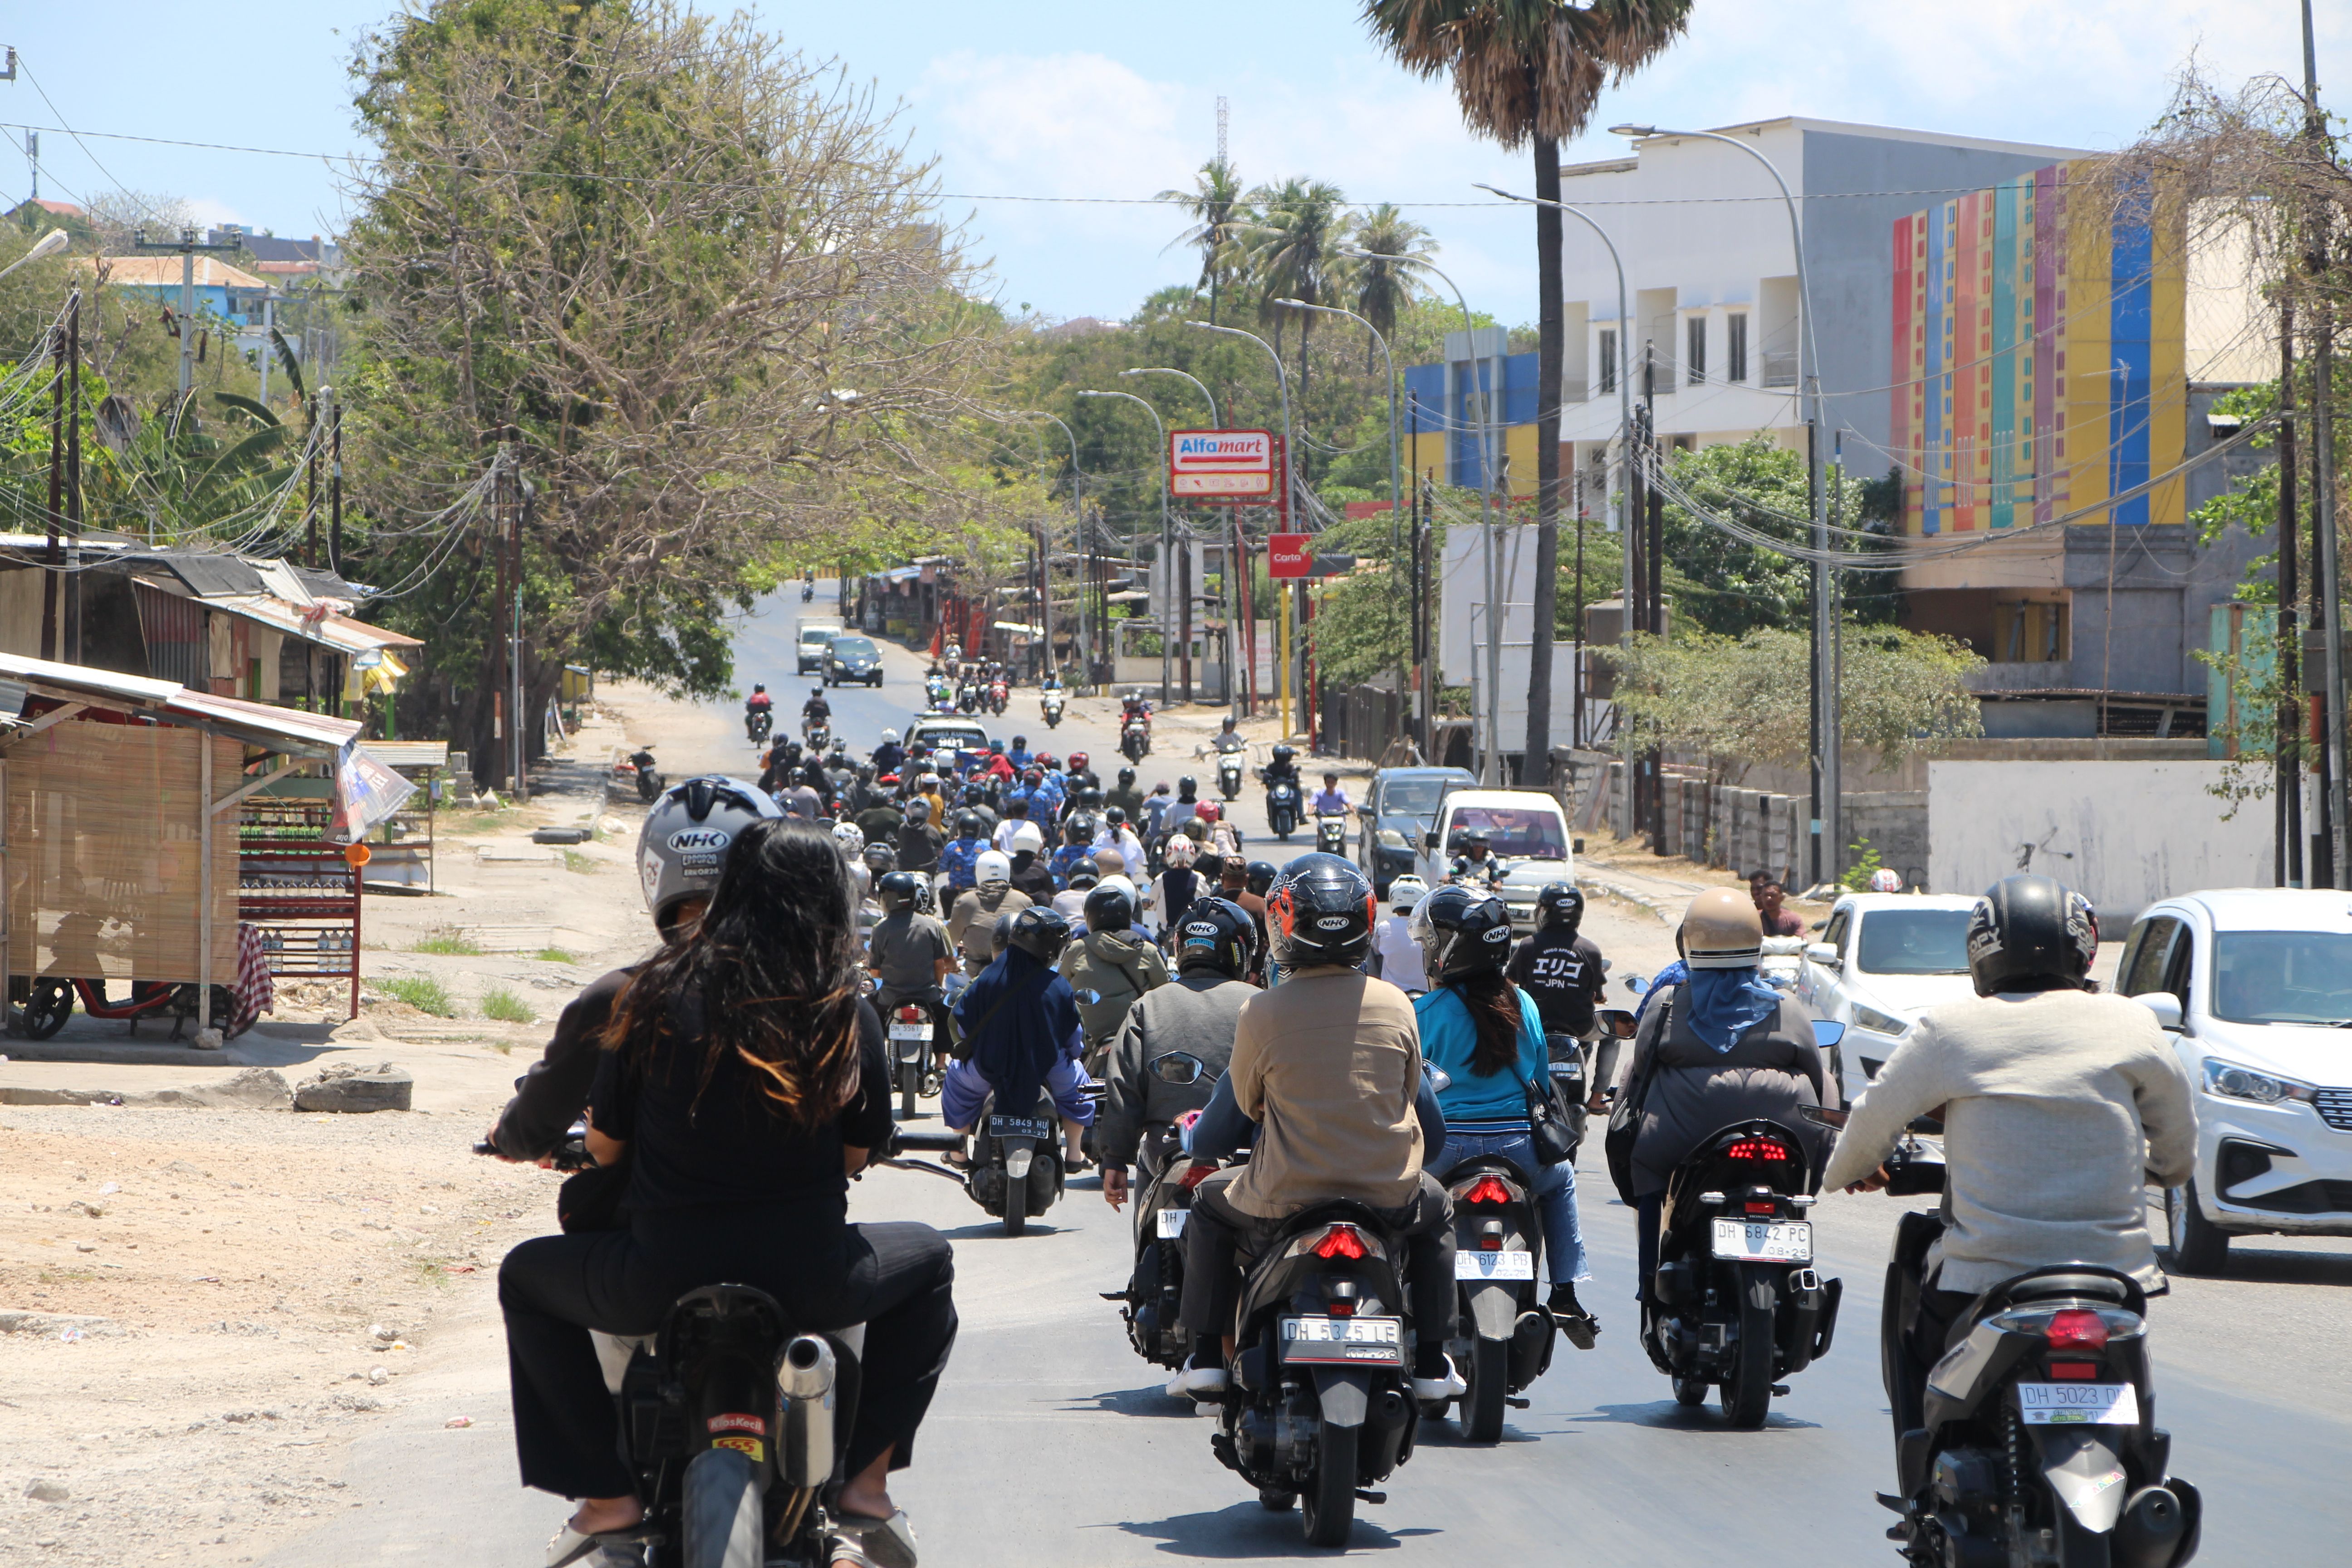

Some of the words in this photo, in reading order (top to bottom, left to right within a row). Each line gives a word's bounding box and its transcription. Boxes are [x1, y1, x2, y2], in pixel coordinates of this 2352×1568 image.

[1180, 438, 1263, 453] Alfamart
[1274, 553, 1301, 562] Carta
[951, 731, 979, 739] KUPANG
[675, 832, 720, 848] NHK
[1190, 924, 1214, 933] NHK
[1322, 919, 1345, 927] NHK
[1488, 927, 1507, 941] NHK
[1558, 948, 1577, 958] APPAREL
[1533, 958, 1584, 979] エリゴ
[1545, 979, 1565, 988] JPN
[992, 1117, 1003, 1126] DH
[1009, 1118, 1032, 1127] 5849
[1037, 1120, 1047, 1129] HU
[1161, 1212, 1176, 1223] DH
[1718, 1224, 1736, 1238] DH
[1746, 1225, 1781, 1240] 6842
[1789, 1227, 1806, 1242] PC
[1456, 1252, 1471, 1265] DH
[1479, 1253, 1505, 1266] 6123
[1513, 1254, 1528, 1266] PB
[1288, 1323, 1309, 1340] DH
[1375, 1326, 1396, 1343] LE
[2025, 1387, 2049, 1405] DH
[2056, 1387, 2098, 1404] 5023
[2106, 1388, 2131, 1405] DM
